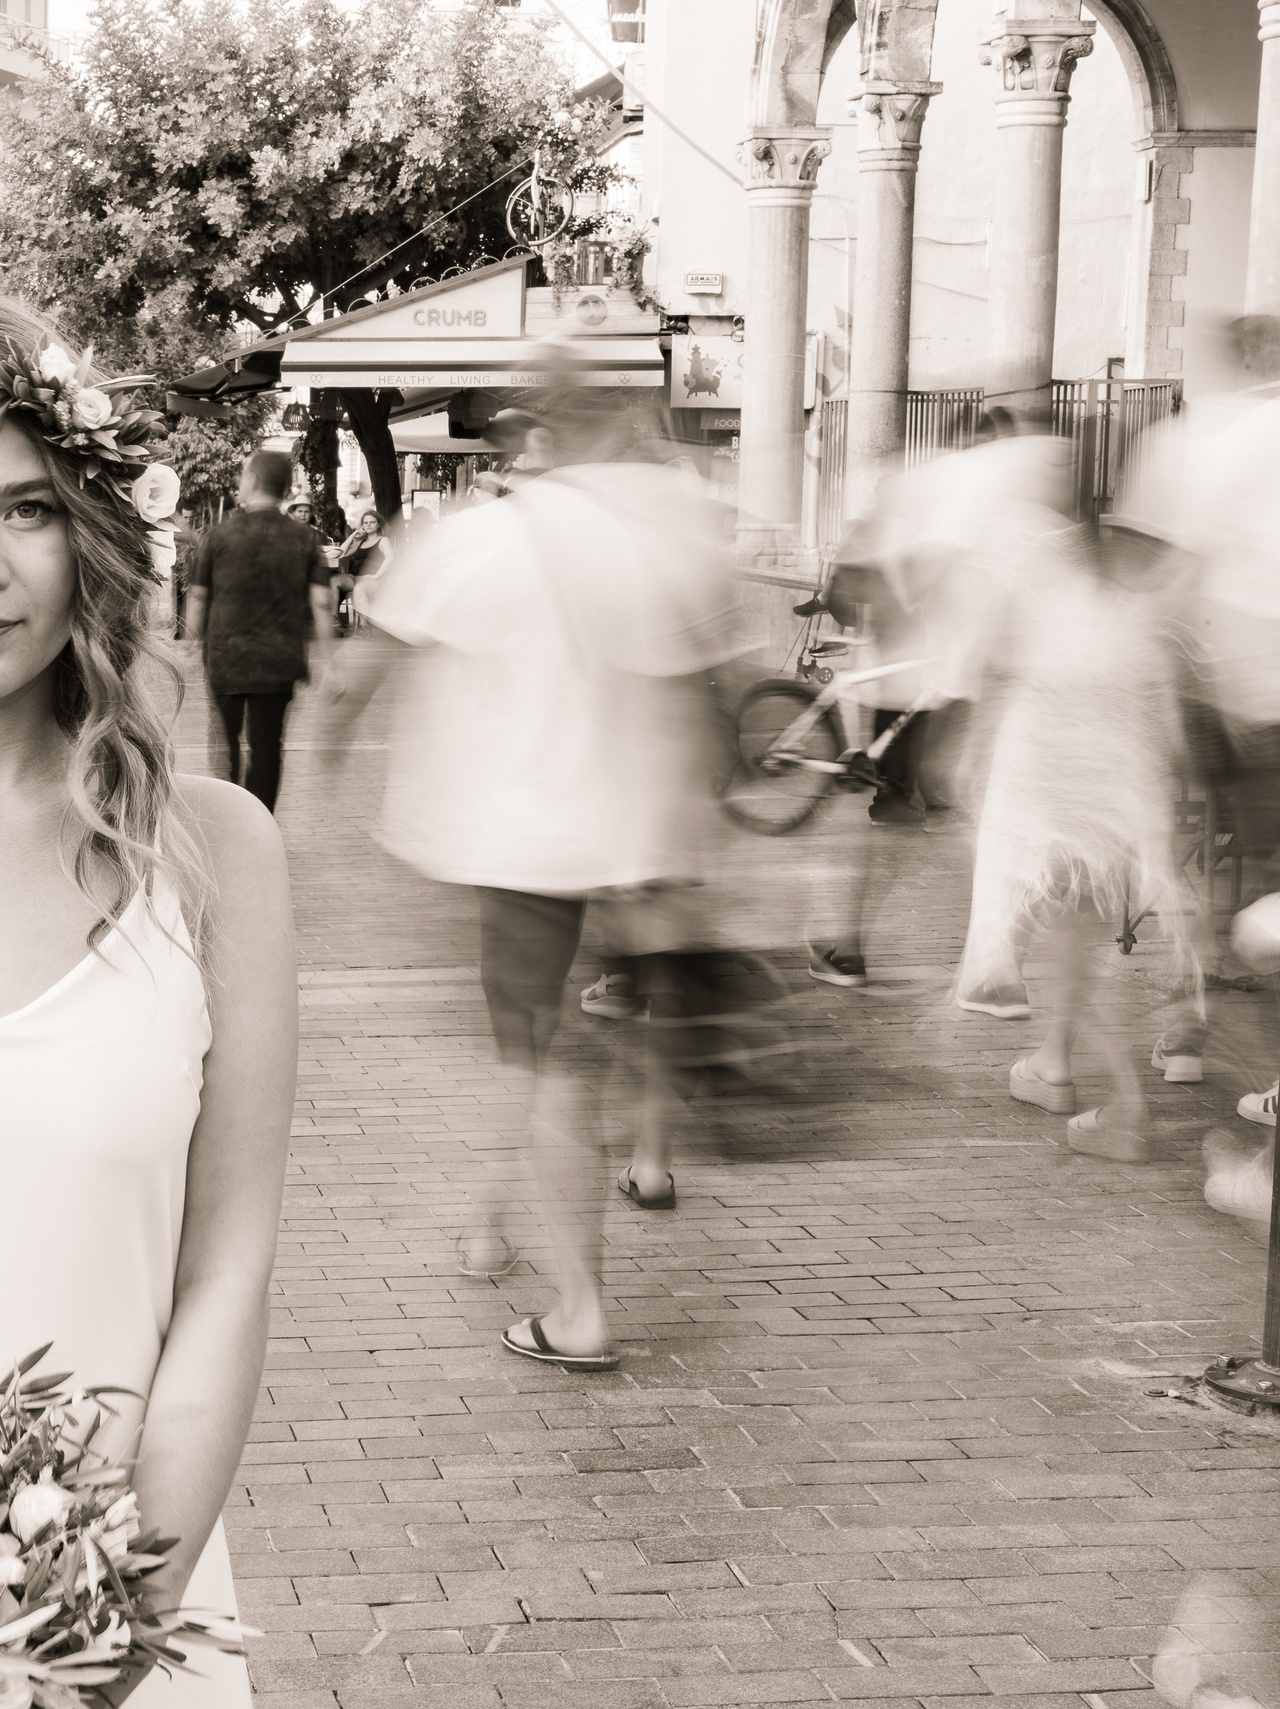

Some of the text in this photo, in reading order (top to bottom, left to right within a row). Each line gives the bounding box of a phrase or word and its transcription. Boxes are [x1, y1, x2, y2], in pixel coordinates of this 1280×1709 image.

[412, 308, 487, 327] CRUMB
[378, 375, 552, 385] HEALTHY LIVING BAKER
